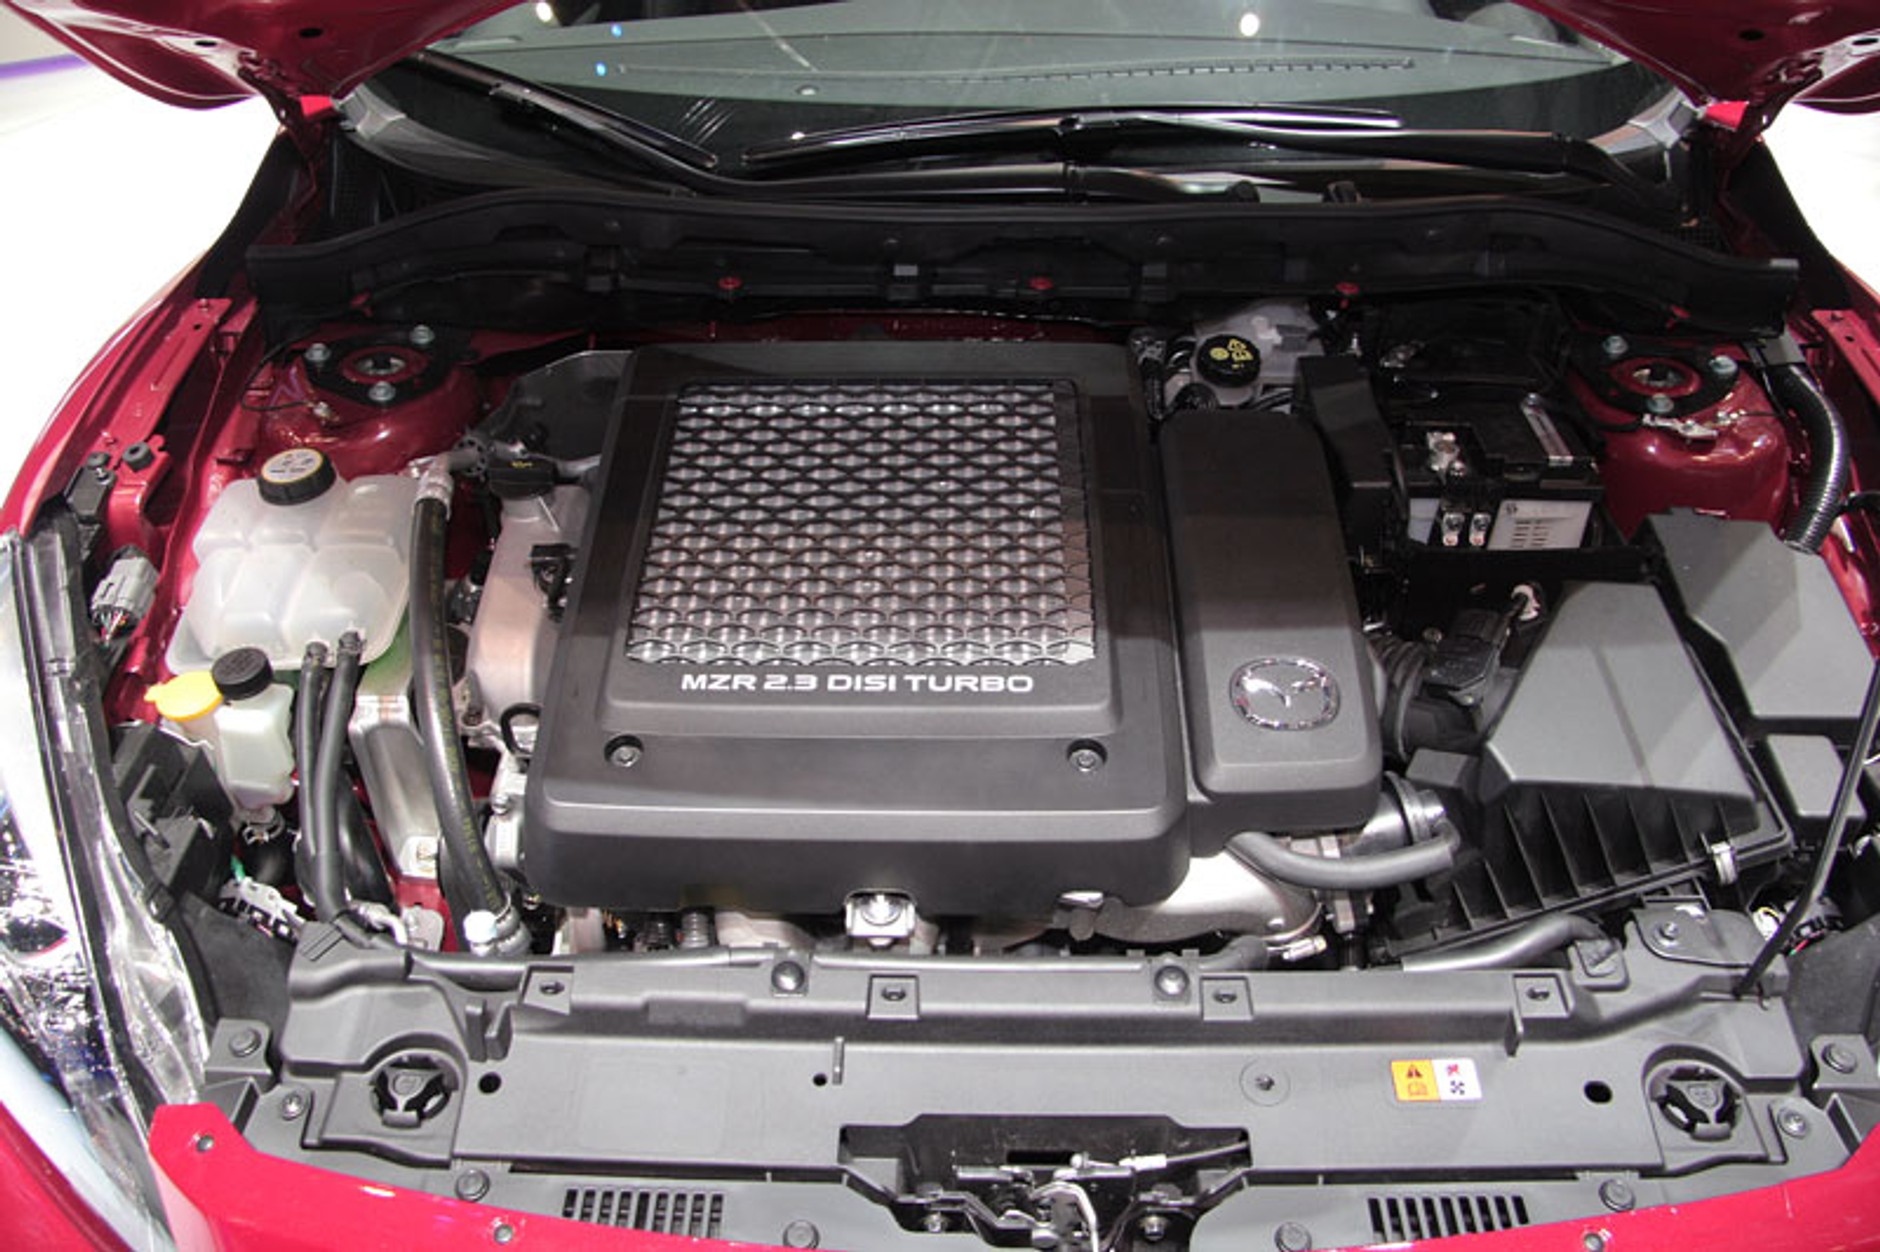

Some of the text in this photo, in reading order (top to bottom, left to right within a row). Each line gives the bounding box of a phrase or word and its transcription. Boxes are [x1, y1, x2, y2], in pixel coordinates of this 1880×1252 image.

[681, 674, 1034, 692] MZR 2.3 DISI TURBO
